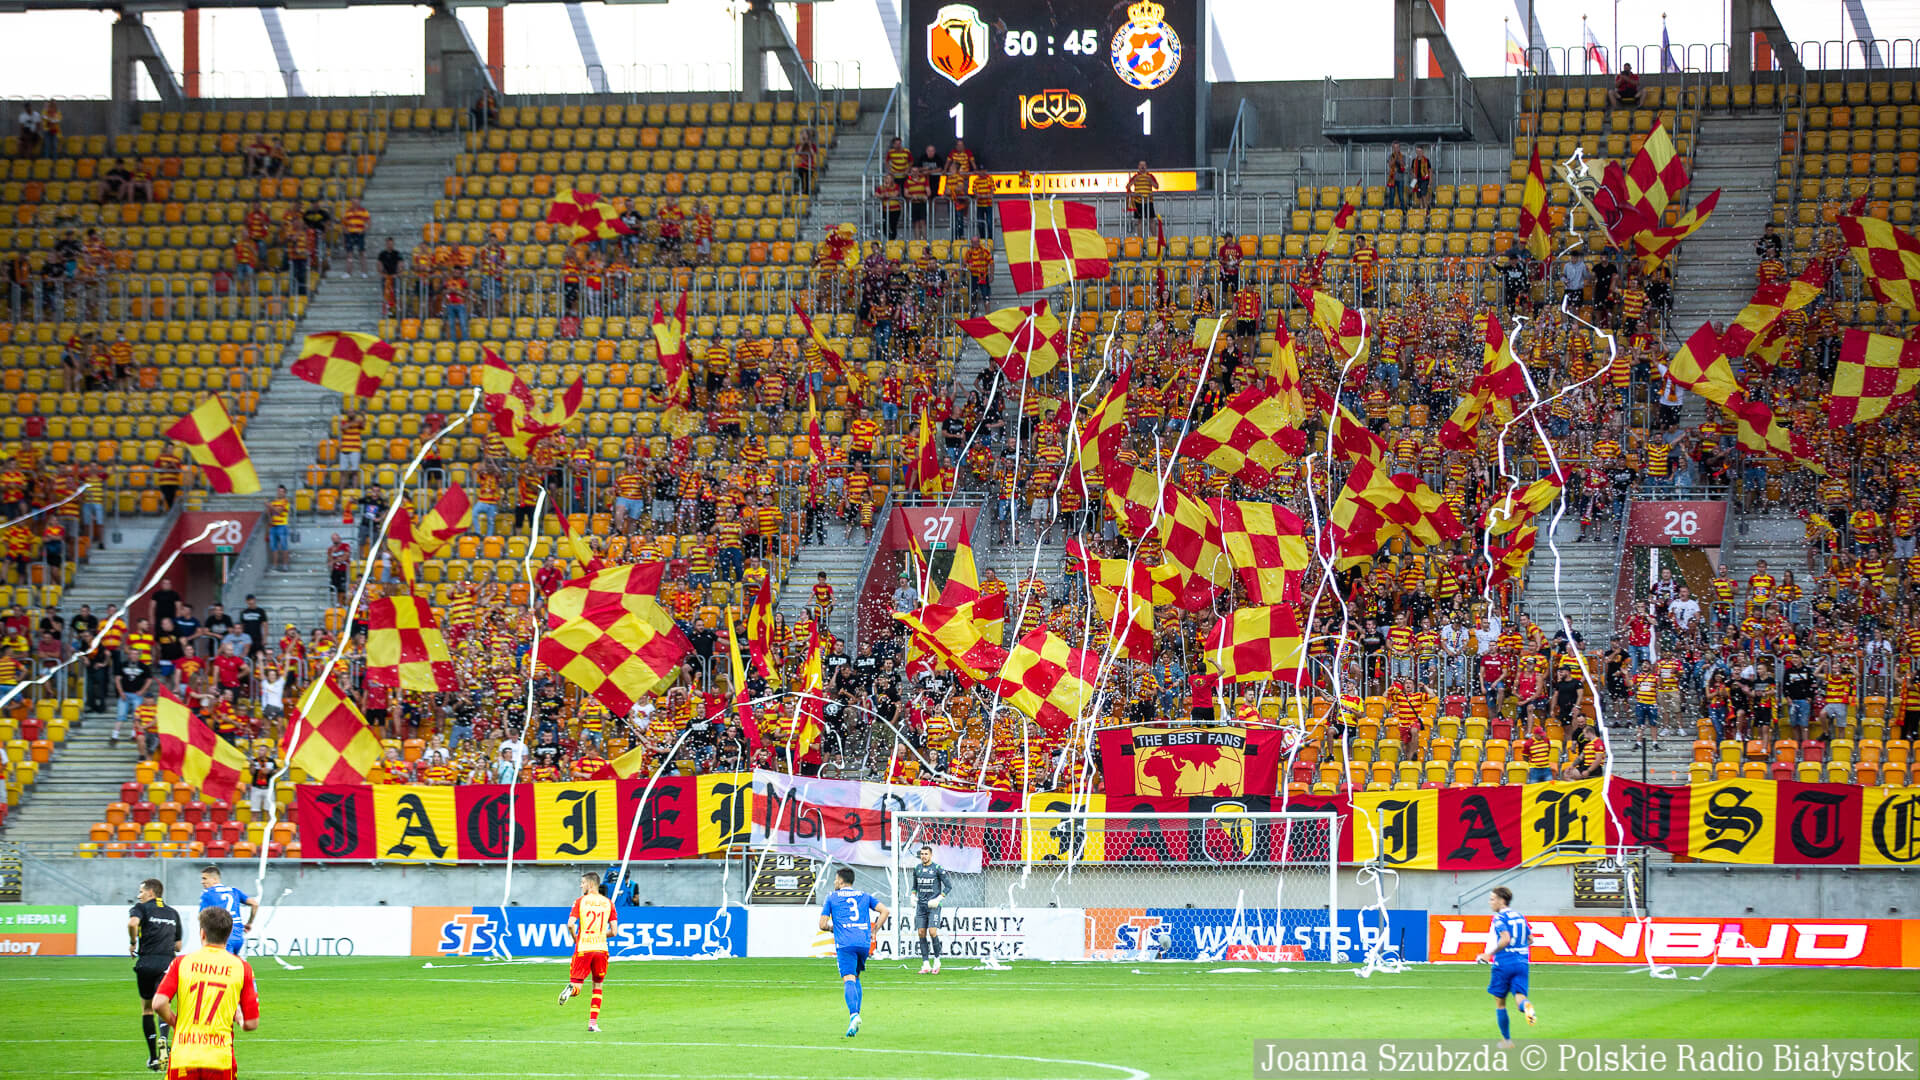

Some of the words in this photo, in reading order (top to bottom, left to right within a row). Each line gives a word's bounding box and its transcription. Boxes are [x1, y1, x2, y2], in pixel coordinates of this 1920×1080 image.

[1004, 30, 1038, 56] 50
[1064, 30, 1098, 56] 45
[949, 102, 963, 138] 1
[1136, 99, 1151, 135] 1
[211, 520, 242, 544] 28
[924, 517, 954, 542] 27
[1664, 511, 1697, 535] 26
[1137, 734, 1163, 747] THE
[1168, 732, 1203, 745] BEST
[1207, 733, 1241, 748] FANS
[778, 855, 793, 866] 21
[1598, 857, 1614, 869] 20
[221, 893, 236, 915] 2
[846, 897, 860, 921] 3
[438, 914, 498, 955] STS
[585, 911, 605, 934] 21
[1115, 916, 1172, 952] STS
[288, 937, 354, 957] AUTO
[517, 923, 720, 947] WW.STS.PL
[1194, 926, 1399, 951] WWWSTS.PL
[1440, 920, 1868, 960] HANBUD
[191, 962, 233, 977] RUNJE
[190, 980, 228, 1025] 17
